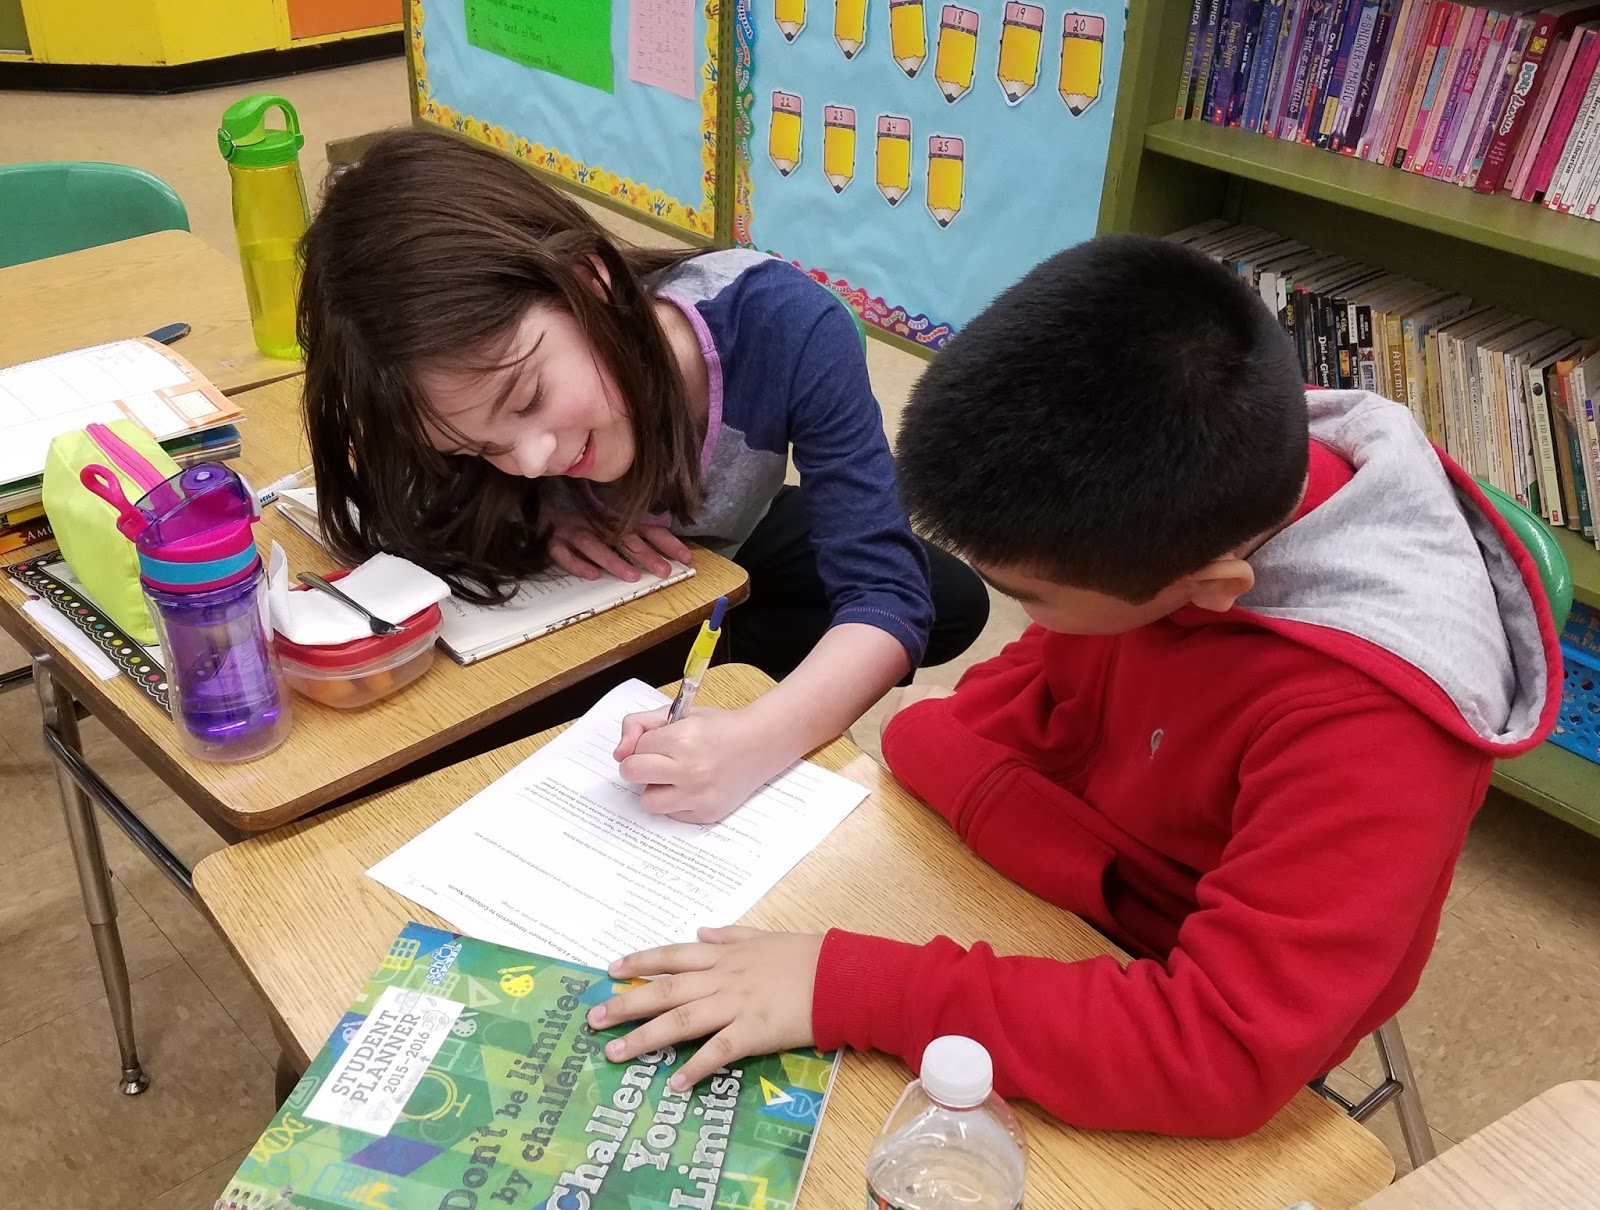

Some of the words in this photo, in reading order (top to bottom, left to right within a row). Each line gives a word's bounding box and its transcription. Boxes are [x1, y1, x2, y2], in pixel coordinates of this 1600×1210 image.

[952, 11, 963, 25] 18
[1015, 8, 1026, 21] 19
[1072, 19, 1087, 33] 20
[1191, 0, 1201, 25] UPICA
[1208, 0, 1218, 26] UPICA
[1327, 31, 1336, 43] Oh
[1351, 21, 1371, 61] SNICKER
[1322, 57, 1330, 68] It's
[1514, 61, 1537, 95] DORK
[1317, 68, 1328, 90] Robert
[1341, 70, 1358, 102] MAGIC
[780, 97, 792, 109] 22
[833, 111, 844, 122] 23
[1499, 94, 1525, 137] diaries
[886, 121, 898, 133] 24
[1583, 114, 1594, 131] Lies
[937, 141, 950, 153] 25
[1564, 139, 1584, 175] Librarian
[1575, 136, 1594, 175] CHRISTOPHER
[1317, 335, 1329, 387] Dial-a-Ghost
[1391, 350, 1404, 398] ARTEMIS
[506, 976, 591, 1086] limited
[331, 1010, 398, 1096] STUDENT
[349, 1013, 421, 1104] PLANNER
[490, 1169, 533, 1206] by
[521, 1008, 601, 1163] challenge
[495, 1090, 528, 1120] be
[546, 1045, 677, 1210] Challeng
[438, 1125, 508, 1210] Don't
